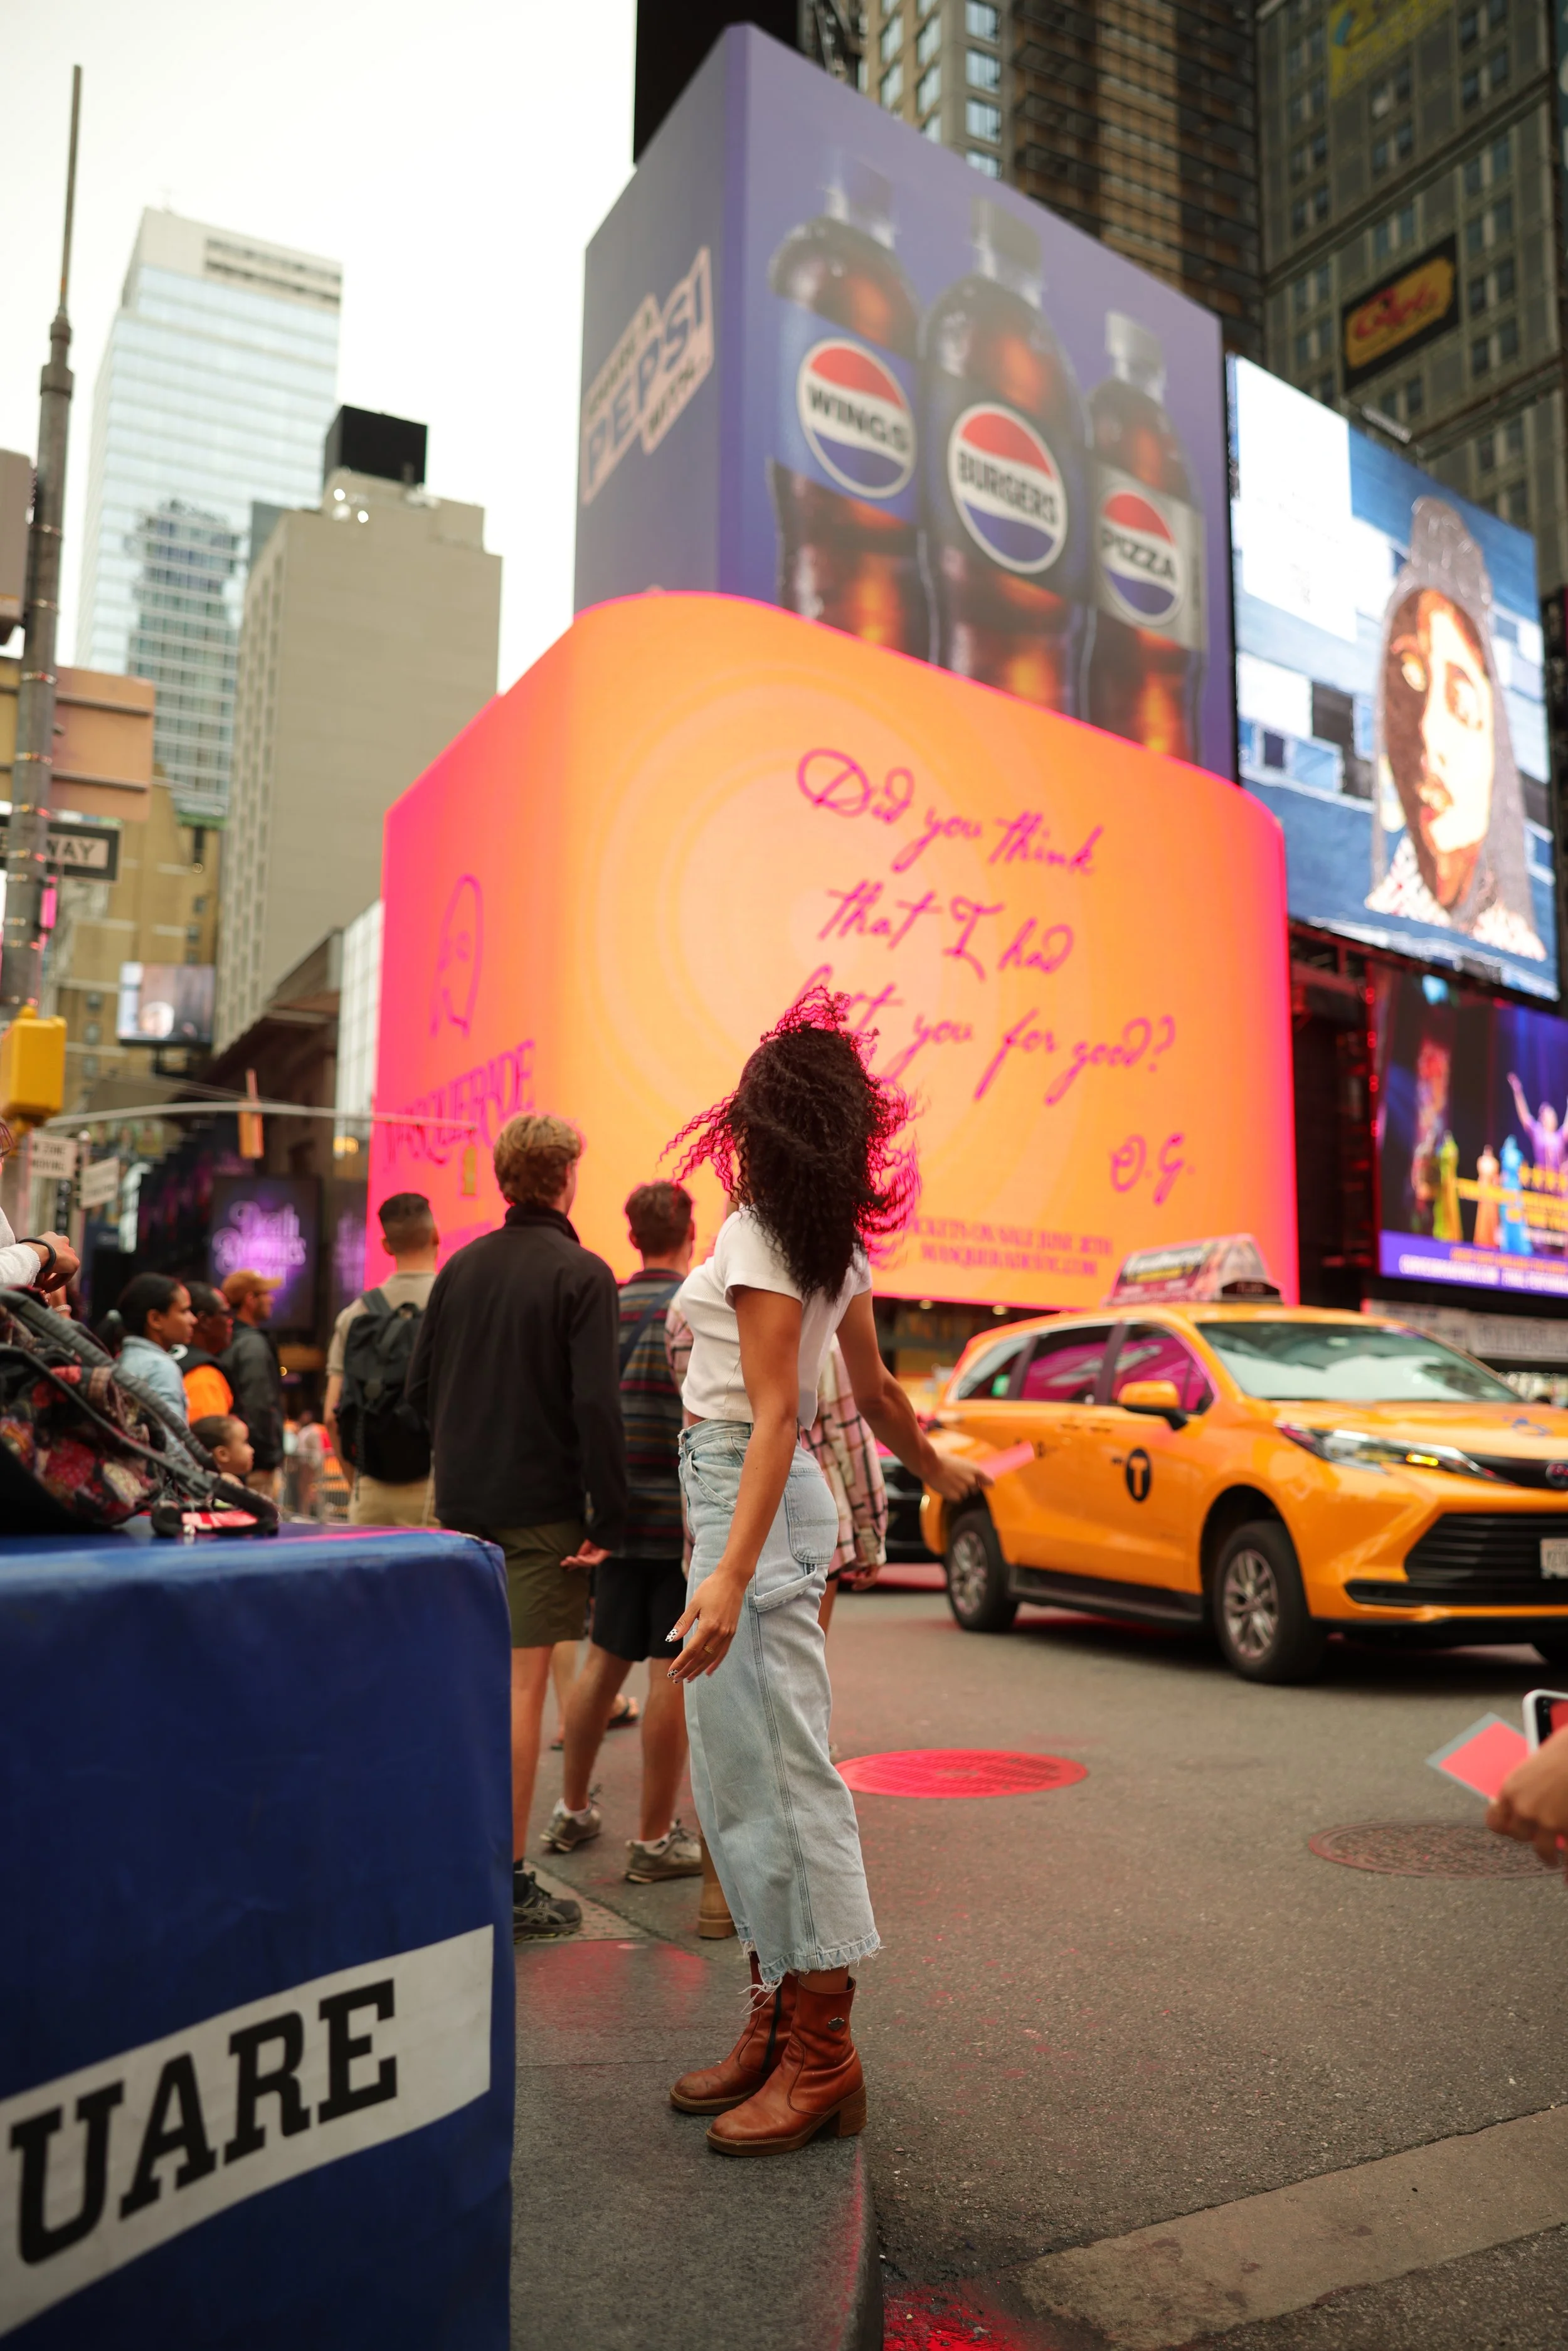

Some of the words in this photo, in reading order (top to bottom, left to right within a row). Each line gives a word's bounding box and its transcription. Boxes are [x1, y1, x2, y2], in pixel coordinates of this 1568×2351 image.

[583, 254, 712, 502] PEPSI
[806, 383, 911, 454] WINGS
[958, 448, 1060, 526] BURGERS
[1101, 526, 1175, 582] PIZZA
[797, 748, 914, 824] Did
[891, 808, 982, 873] you
[987, 810, 1104, 874] think
[817, 879, 943, 950] that
[943, 896, 1005, 982] I
[997, 916, 1074, 974] had
[880, 1012, 973, 1085] you
[974, 1007, 1056, 1101] for
[1044, 1014, 1177, 1106] good?
[8, 1977, 398, 2266] UARE
